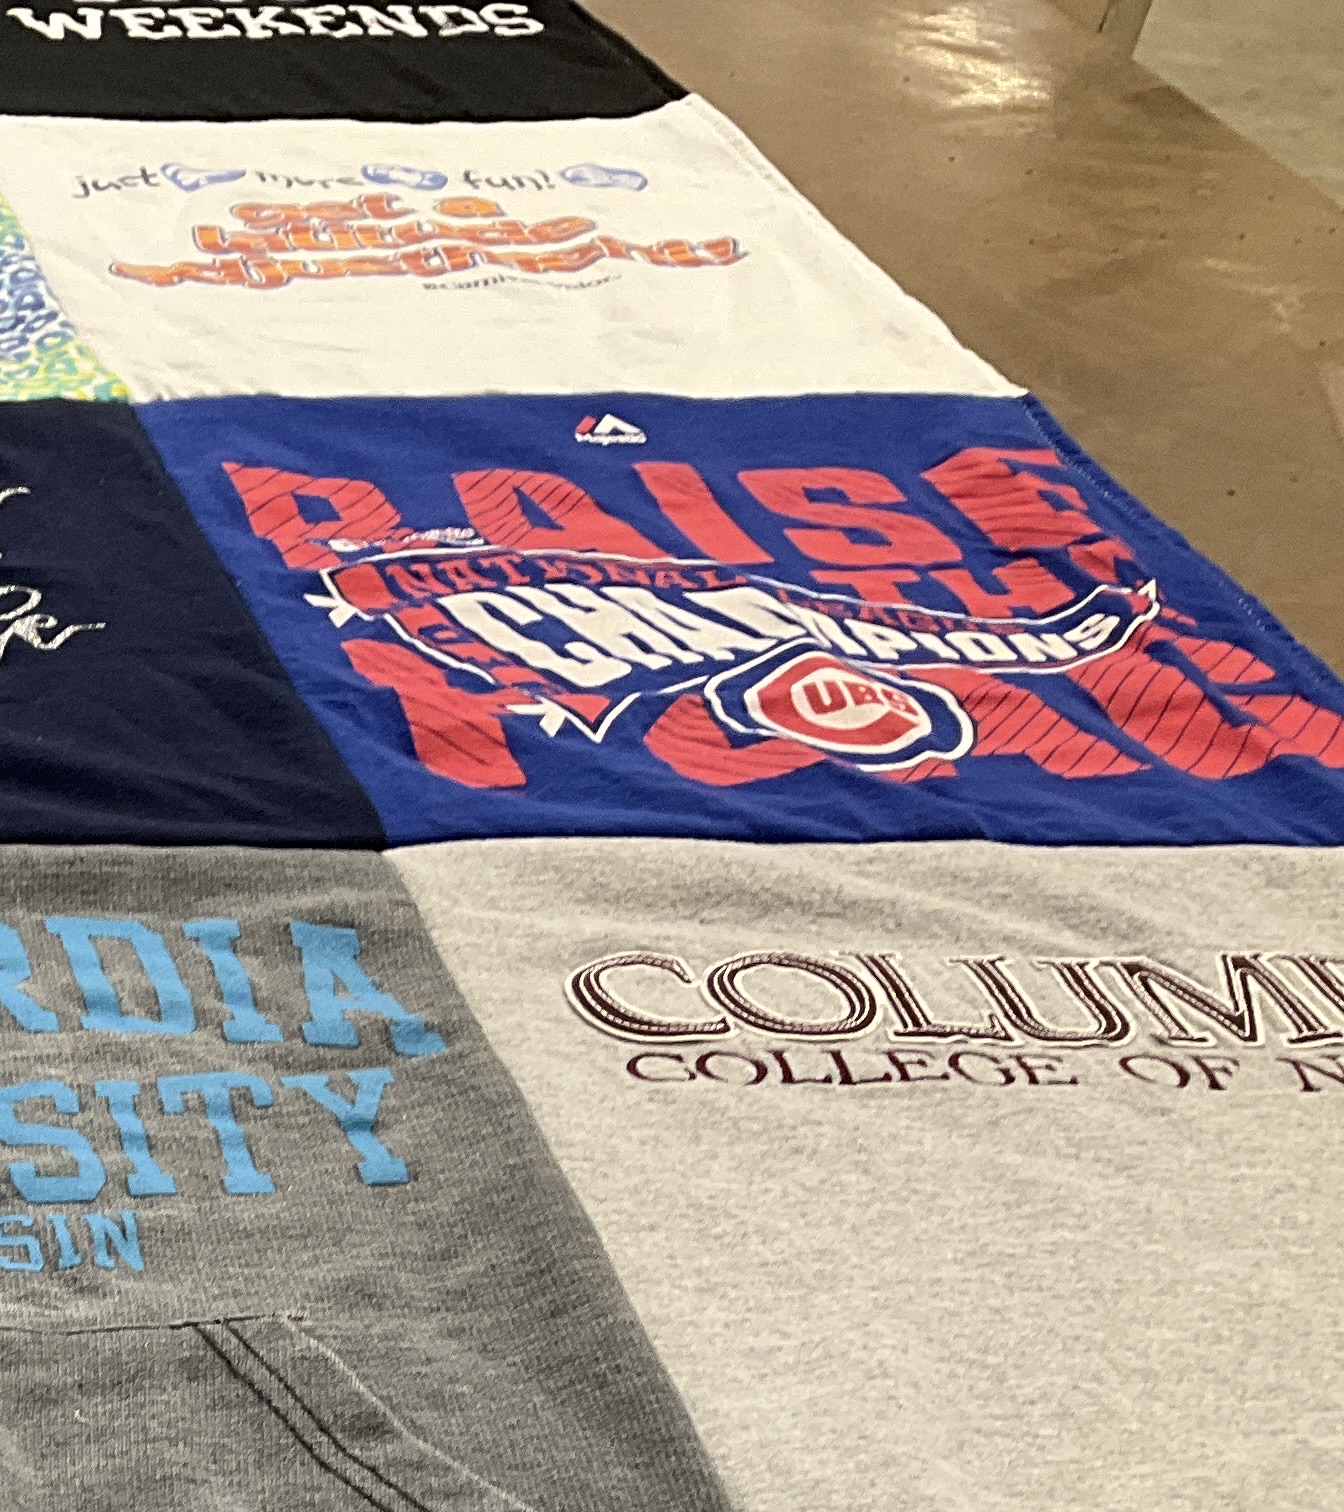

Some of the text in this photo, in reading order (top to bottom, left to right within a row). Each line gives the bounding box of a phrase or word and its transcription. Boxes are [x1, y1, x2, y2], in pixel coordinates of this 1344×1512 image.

[5, 2, 545, 40] WEEKENDS
[72, 166, 160, 198] just
[462, 168, 557, 191] fun!
[221, 446, 1104, 568] RAISE
[435, 582, 1121, 688] CHAMPIONS
[625, 1048, 1081, 1087] COLLEGE
[1117, 1054, 1242, 1093] OF
